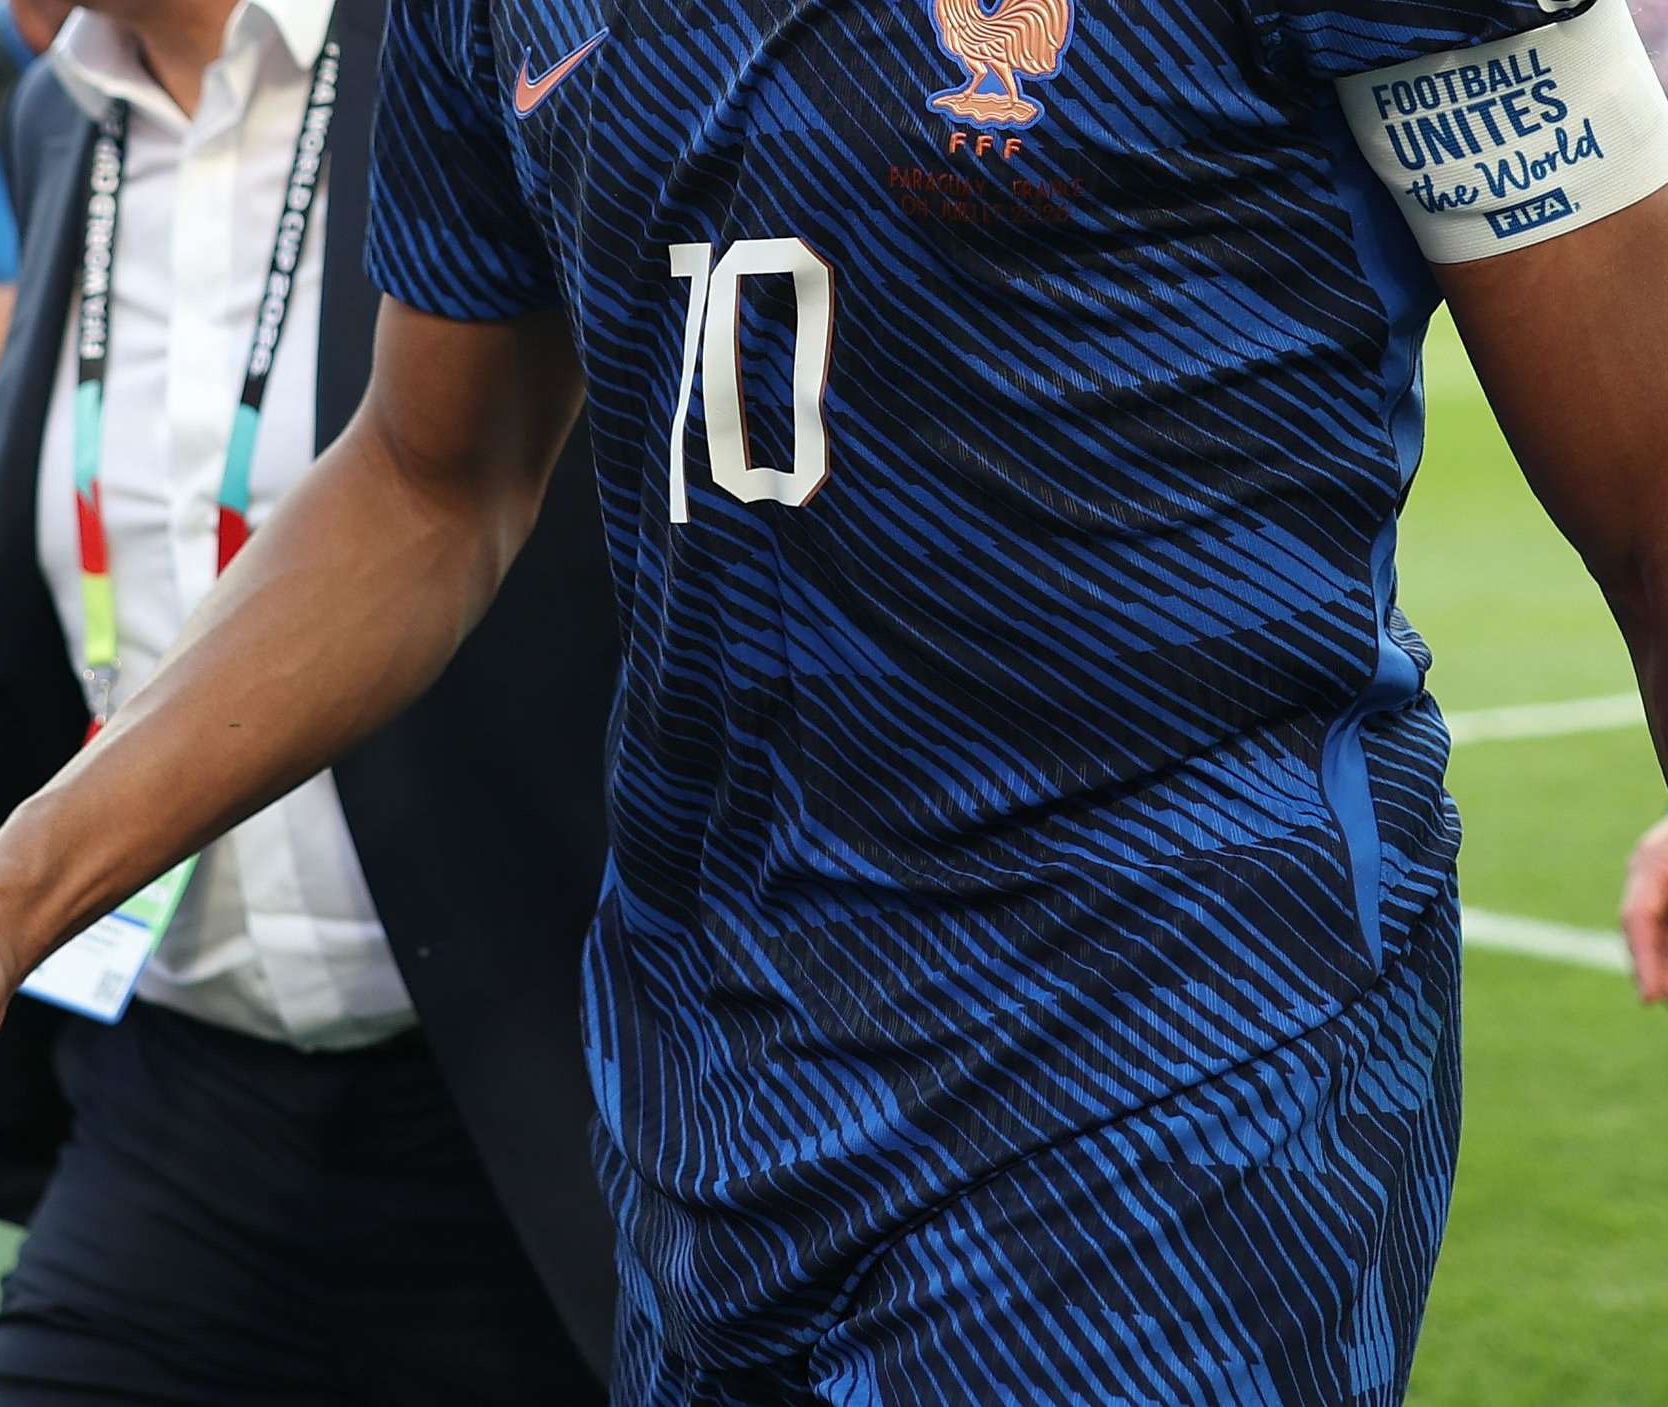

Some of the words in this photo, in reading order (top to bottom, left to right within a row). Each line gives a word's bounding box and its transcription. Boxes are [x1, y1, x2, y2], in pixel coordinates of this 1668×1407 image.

[1372, 48, 1552, 120] FOOTBALL
[1385, 78, 1568, 171] UNITES
[288, 104, 333, 210] WORLD
[1405, 174, 1479, 214] the
[1474, 118, 1604, 199] World
[276, 210, 305, 272] CUP
[1495, 199, 1567, 231] FIFA
[248, 271, 291, 377] 2026
[668, 238, 835, 523] 10
